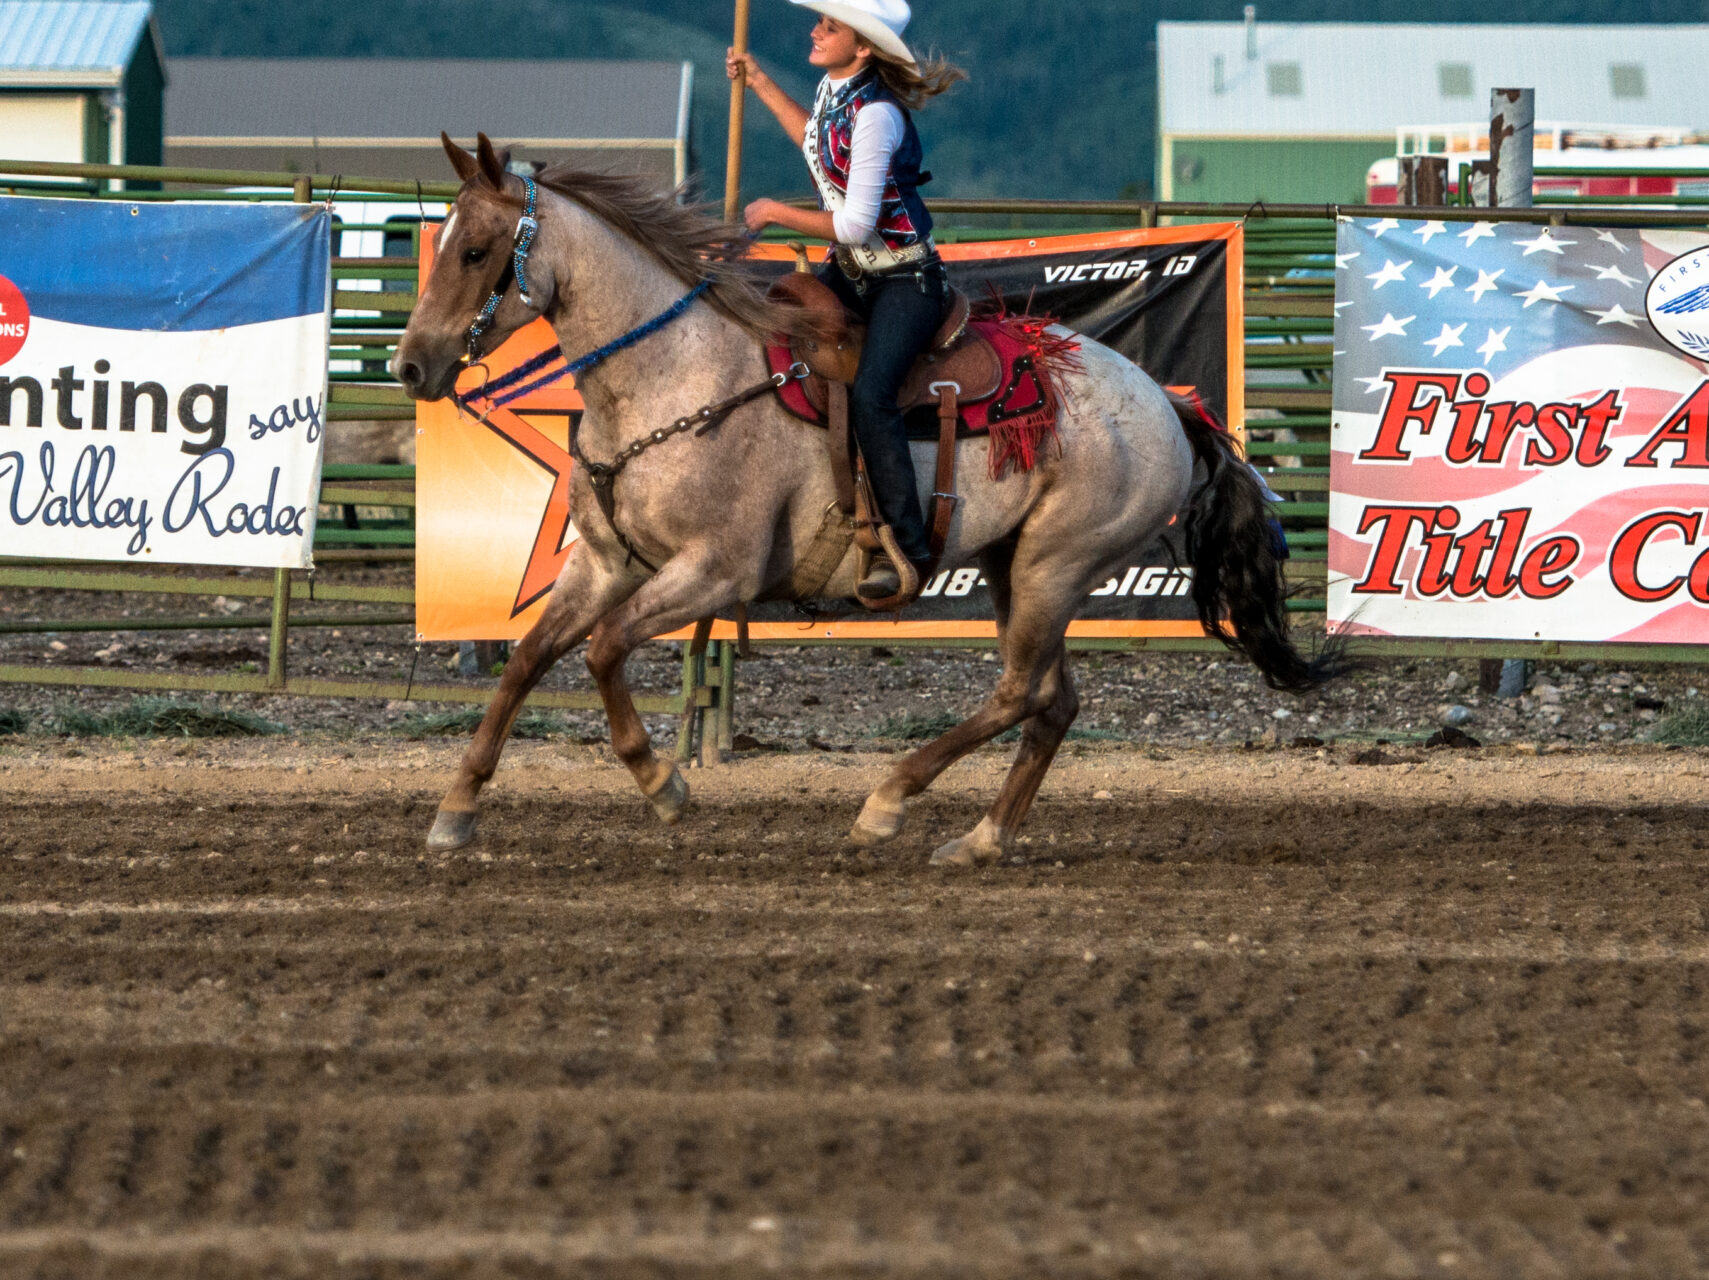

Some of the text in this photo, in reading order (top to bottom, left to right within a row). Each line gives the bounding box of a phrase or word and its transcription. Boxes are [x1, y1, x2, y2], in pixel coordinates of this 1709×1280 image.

[1044, 255, 1198, 283] VICTOR, ID
[1659, 253, 1709, 292] FIRS
[0, 323, 25, 337] NS
[0, 358, 229, 455] nting
[1358, 371, 1622, 467] First
[0, 440, 153, 556] Valley
[1351, 505, 1580, 600] Title
